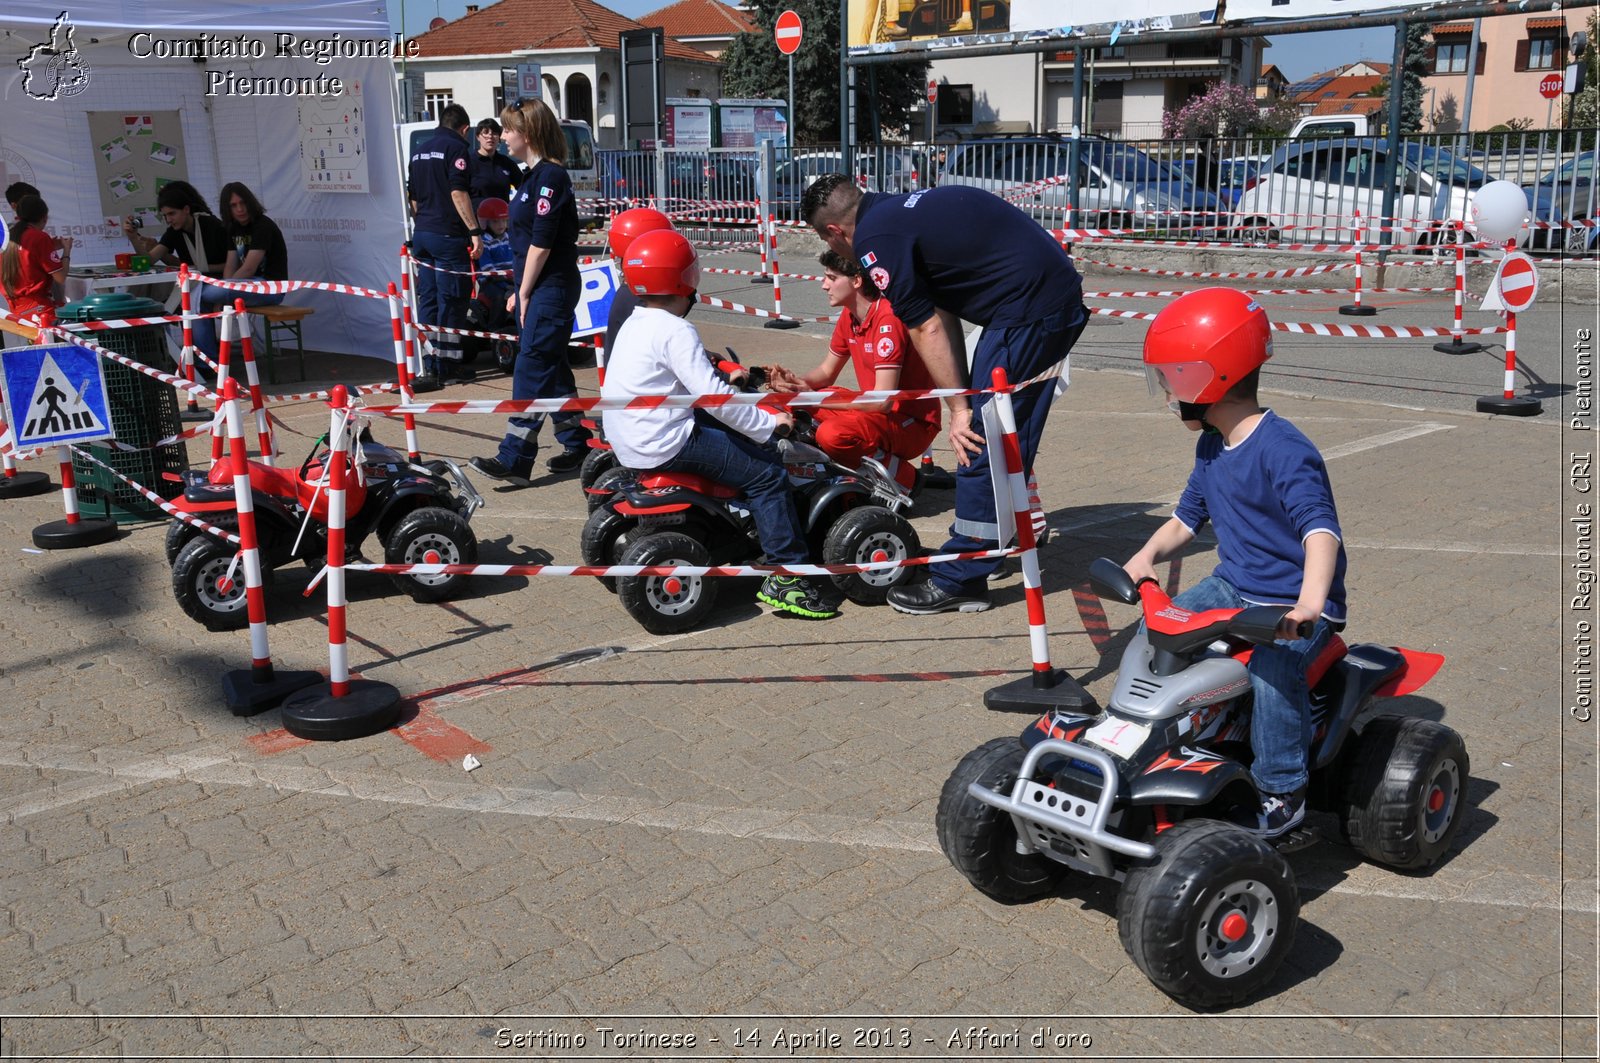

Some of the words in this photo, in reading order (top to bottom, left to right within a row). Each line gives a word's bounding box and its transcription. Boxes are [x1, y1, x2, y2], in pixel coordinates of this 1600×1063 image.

[1541, 81, 1562, 92] STOP
[574, 269, 611, 330] P
[1102, 722, 1132, 746] 1
